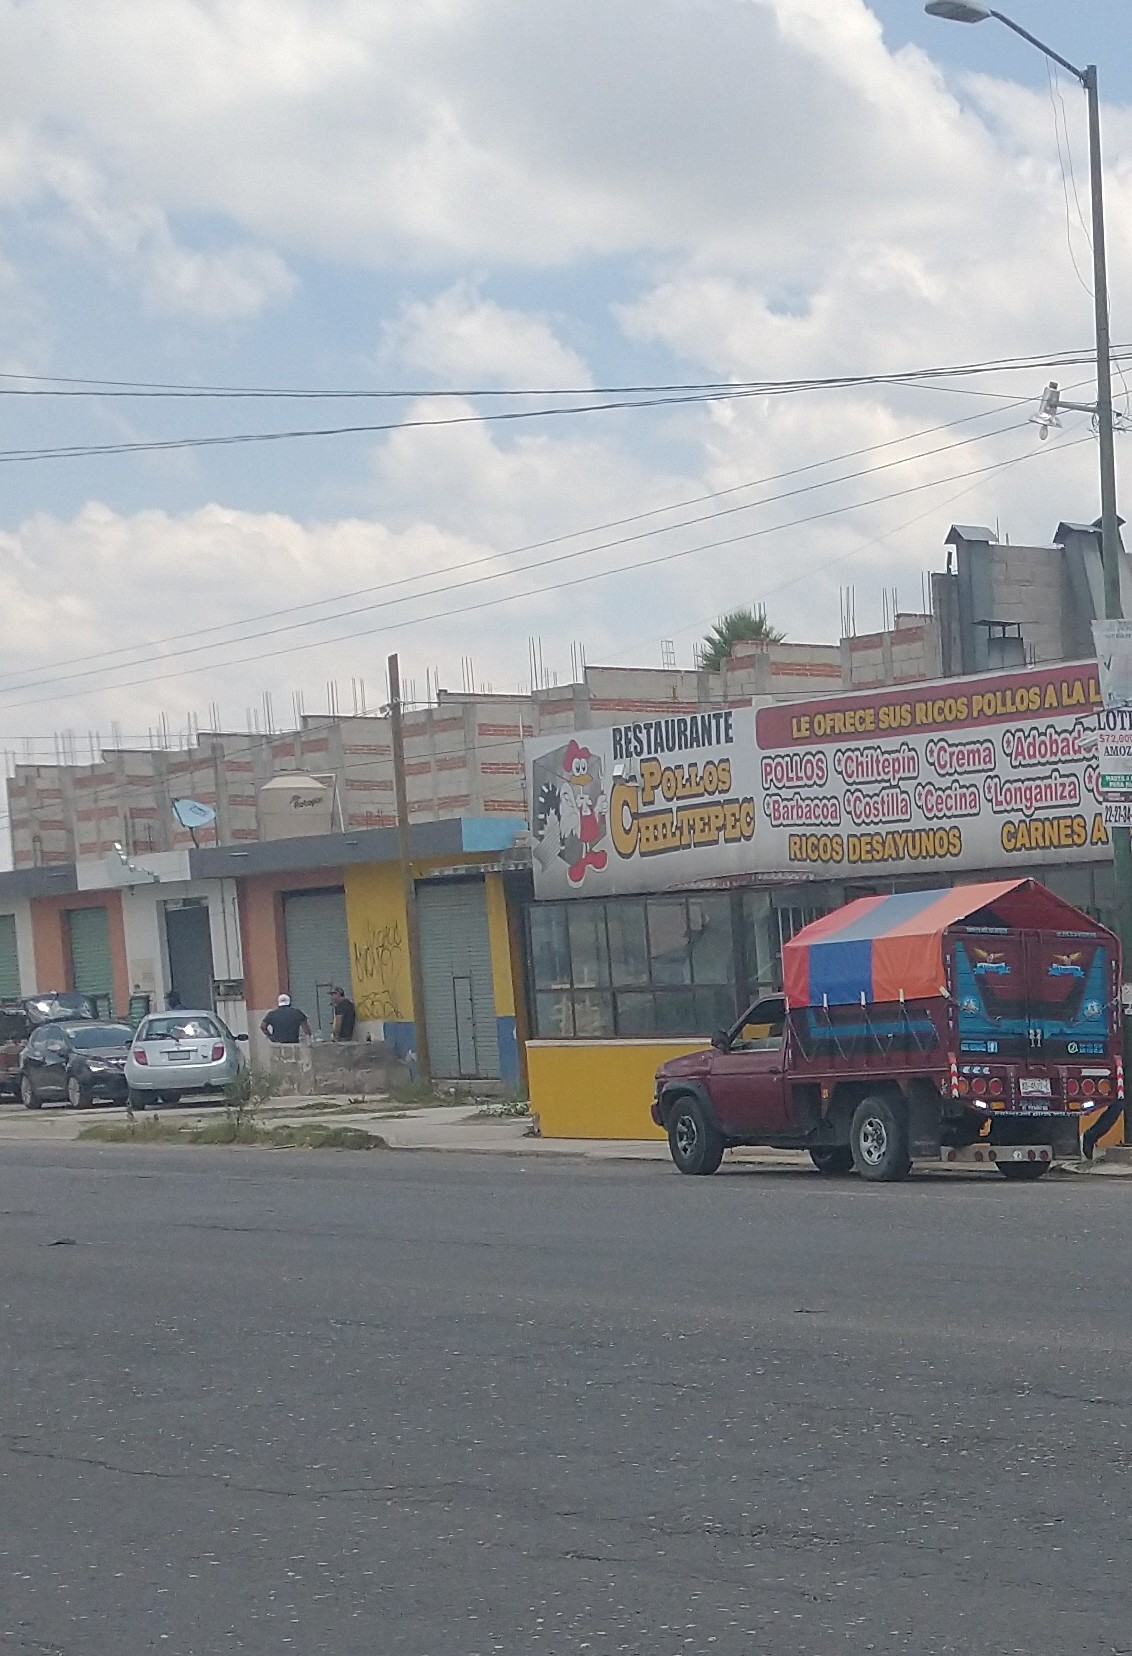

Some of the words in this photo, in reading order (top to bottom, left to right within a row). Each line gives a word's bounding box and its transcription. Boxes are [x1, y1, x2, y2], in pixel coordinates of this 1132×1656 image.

[792, 716, 810, 738] LE
[813, 709, 876, 736] OFRECE
[878, 703, 912, 729] SUS
[915, 696, 968, 725] RICOS
[972, 685, 1041, 718] POLLOS
[1045, 683, 1058, 708] A
[1061, 680, 1084, 706] LA
[612, 711, 733, 760] RESTAURANTE
[763, 755, 828, 786] POLLOS
[844, 747, 917, 784] Chiltepín
[936, 744, 993, 770] Crema
[1013, 729, 1098, 761] Adobad
[640, 757, 731, 806] POLLOS
[772, 796, 839, 822] Barbacoa
[853, 790, 909, 819] Costilla
[924, 783, 978, 813] Cecina
[993, 777, 1078, 810] Longaniza
[610, 783, 755, 859] CHILTEPEC
[789, 833, 844, 862] RICOS
[848, 826, 962, 863] DESAYUNOS
[1001, 815, 1087, 852] CARNES
[1091, 813, 1109, 846] A
